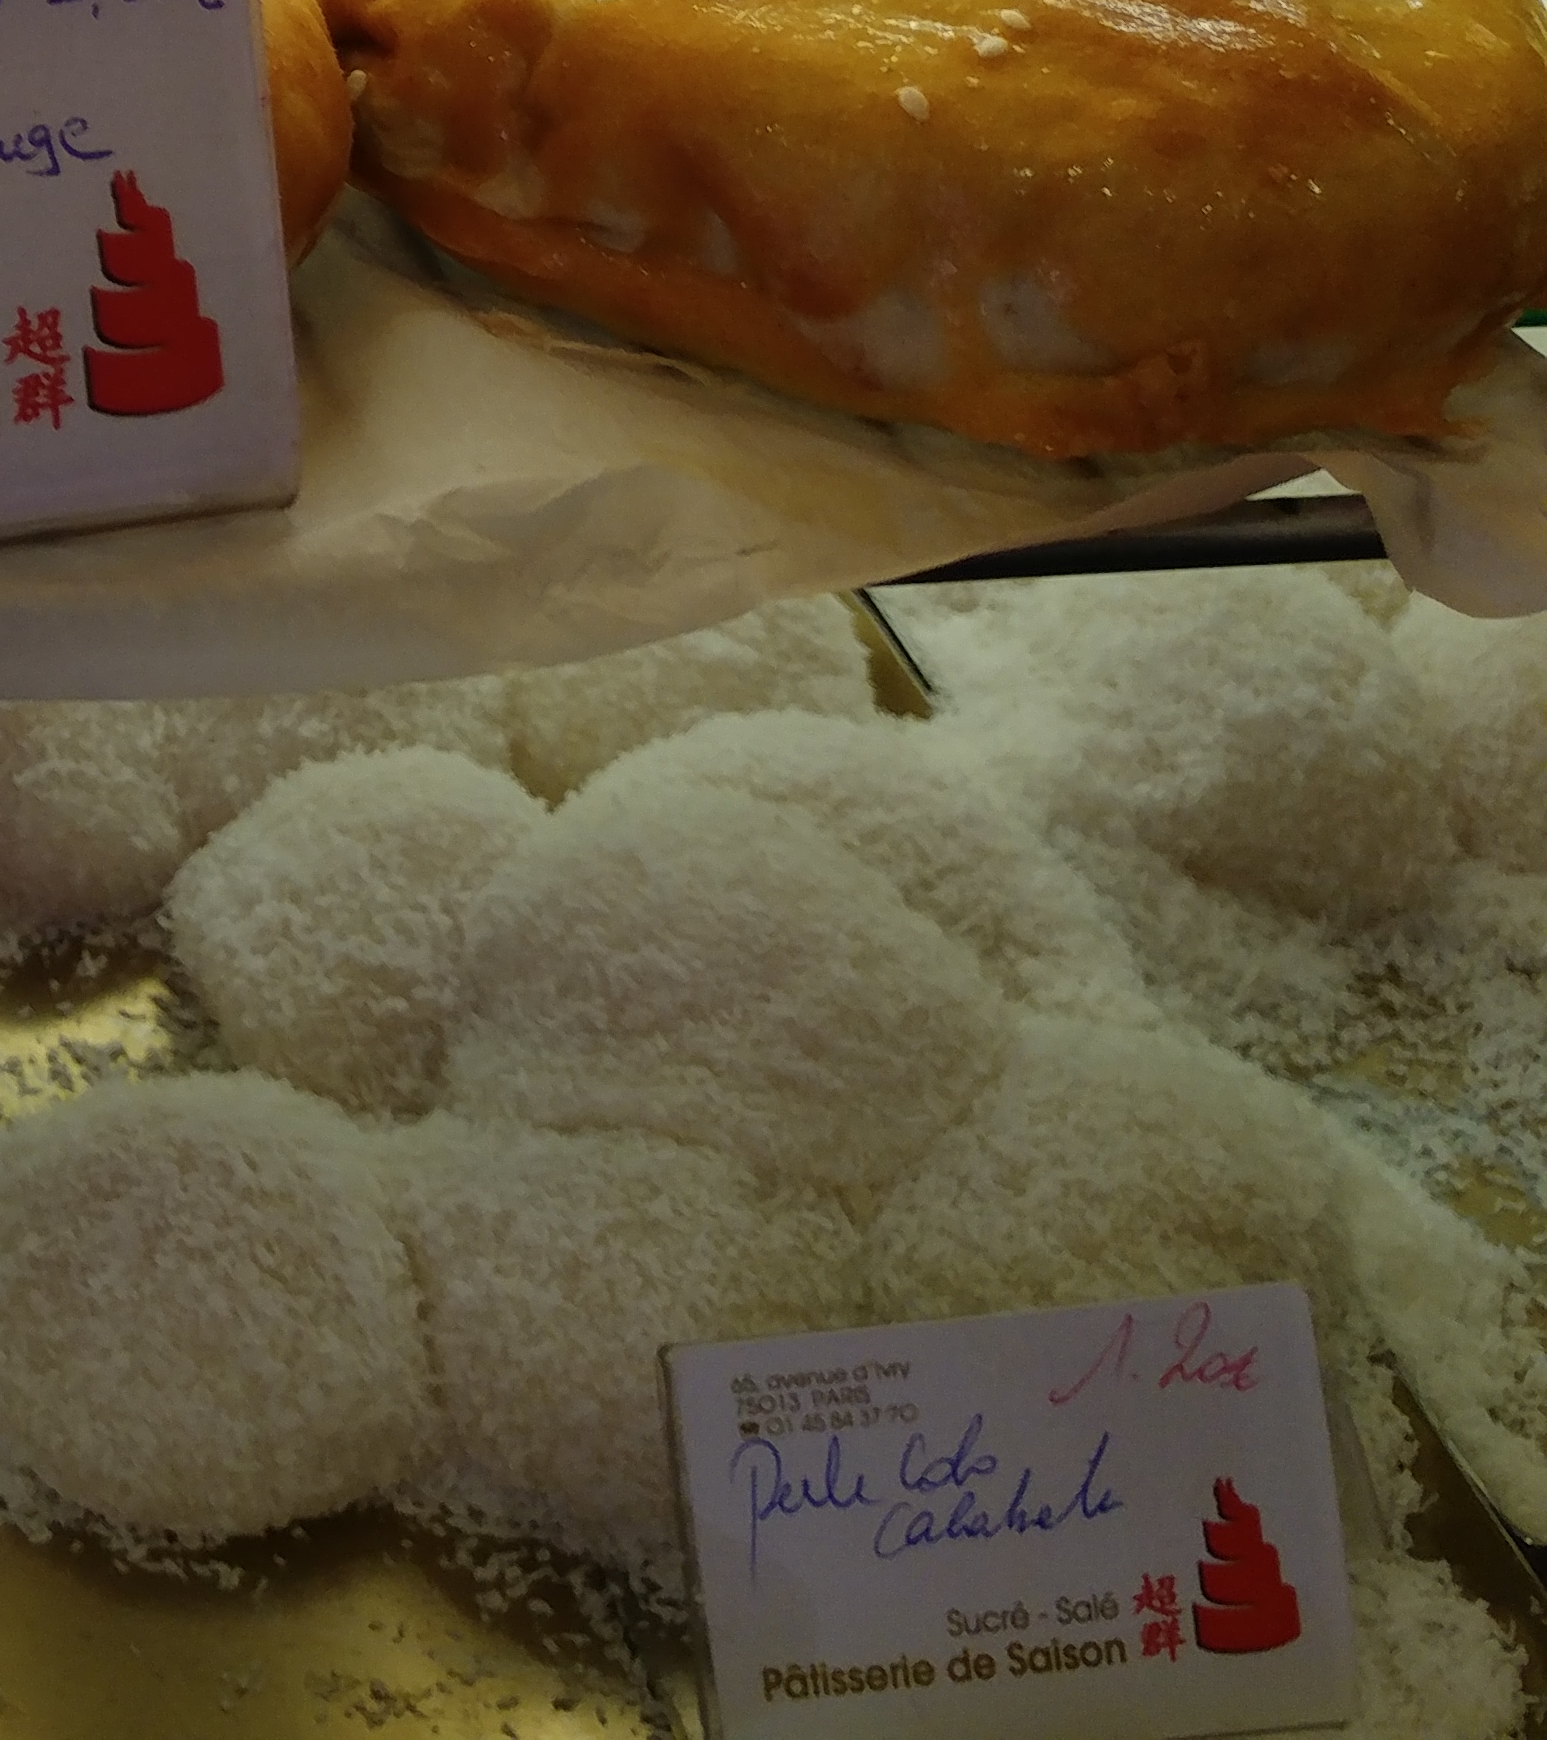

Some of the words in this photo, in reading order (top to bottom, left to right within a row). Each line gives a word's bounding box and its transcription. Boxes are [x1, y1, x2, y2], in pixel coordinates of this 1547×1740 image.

[947, 1606, 1030, 1638] Sucré
[1056, 1590, 1121, 1625] Salé
[762, 1652, 936, 1702] Pâtisserie
[948, 1646, 996, 1681] de
[1007, 1634, 1127, 1677] Saison
